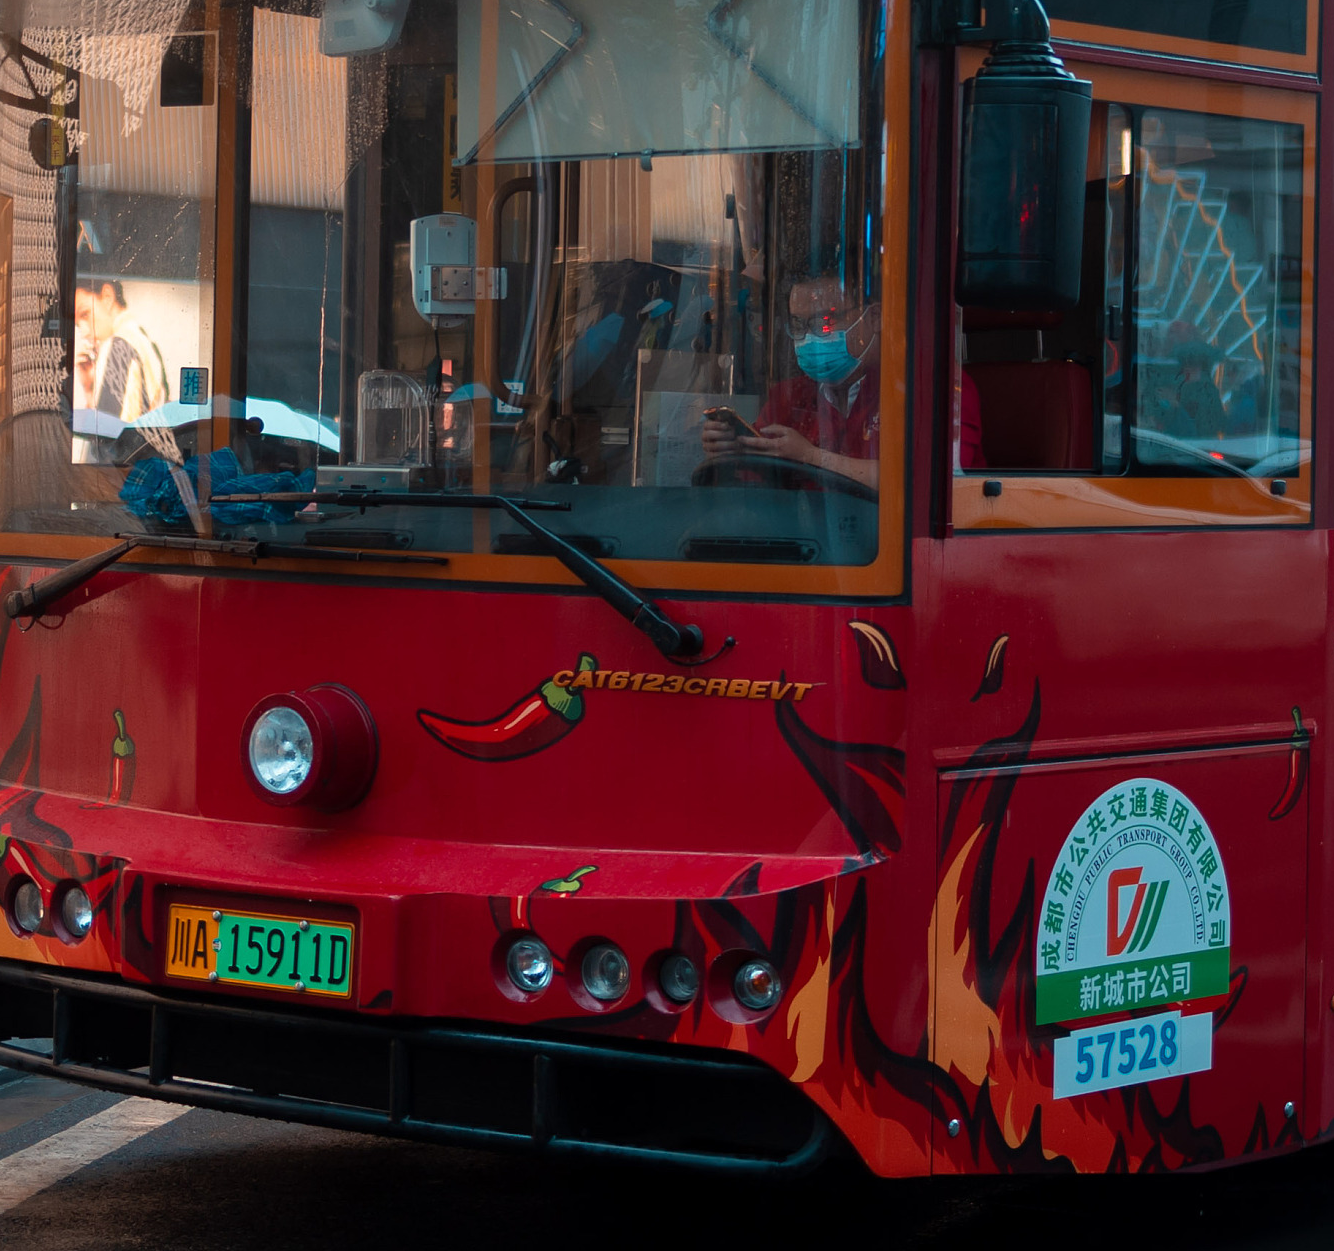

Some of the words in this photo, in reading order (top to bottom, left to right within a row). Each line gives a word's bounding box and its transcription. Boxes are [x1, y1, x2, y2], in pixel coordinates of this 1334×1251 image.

[183, 370, 204, 397] 推
[552, 669, 813, 701] CAT6123CRBEVT
[1040, 786, 1227, 972] 成都市公共交通集团有限公司
[1067, 890, 1086, 962] CHENGDU
[1084, 843, 1114, 886] PUBLIC
[1116, 828, 1168, 848] TRANSPORT
[1169, 844, 1193, 879] GROUP
[227, 923, 349, 985] 15911D
[1079, 961, 1192, 1012] 新城市公司
[1075, 1019, 1179, 1085] 57528
